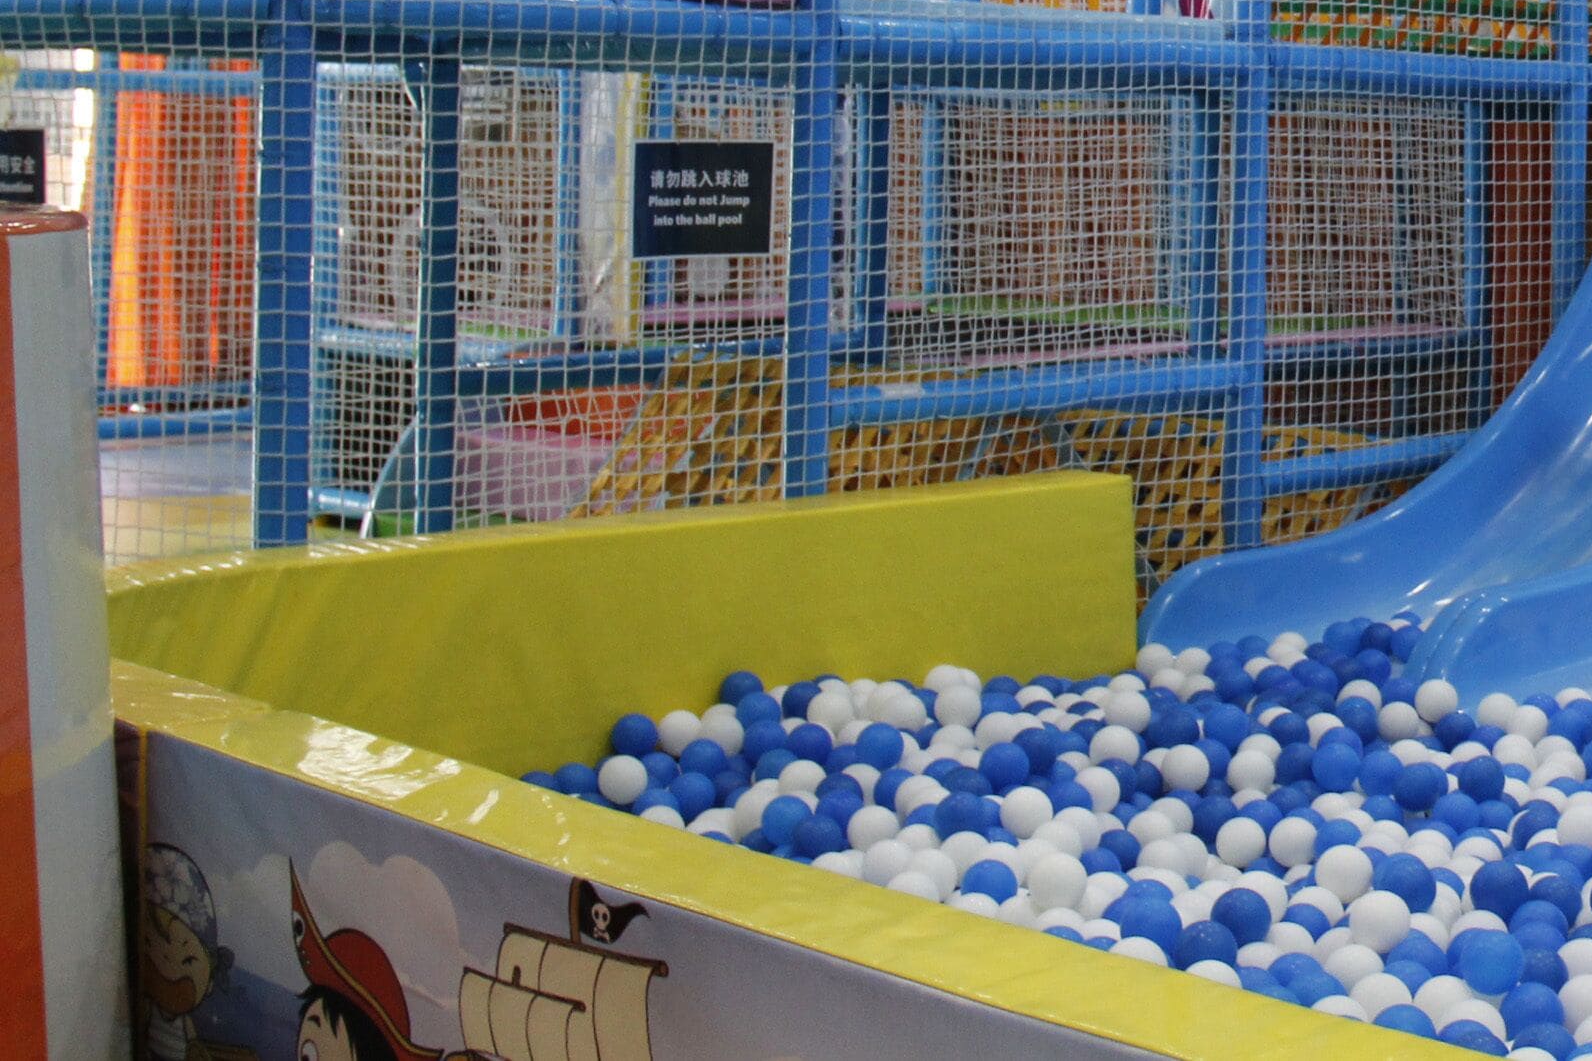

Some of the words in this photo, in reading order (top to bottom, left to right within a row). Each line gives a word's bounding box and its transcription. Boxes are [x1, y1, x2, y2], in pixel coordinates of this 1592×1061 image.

[651, 169, 749, 188] 请勿跳入球池
[648, 195, 681, 207] Please
[683, 194, 697, 206] do
[699, 195, 718, 206] not
[653, 214, 674, 226] into
[675, 214, 693, 226] the
[695, 213, 716, 225] ball
[718, 213, 742, 227] pool
